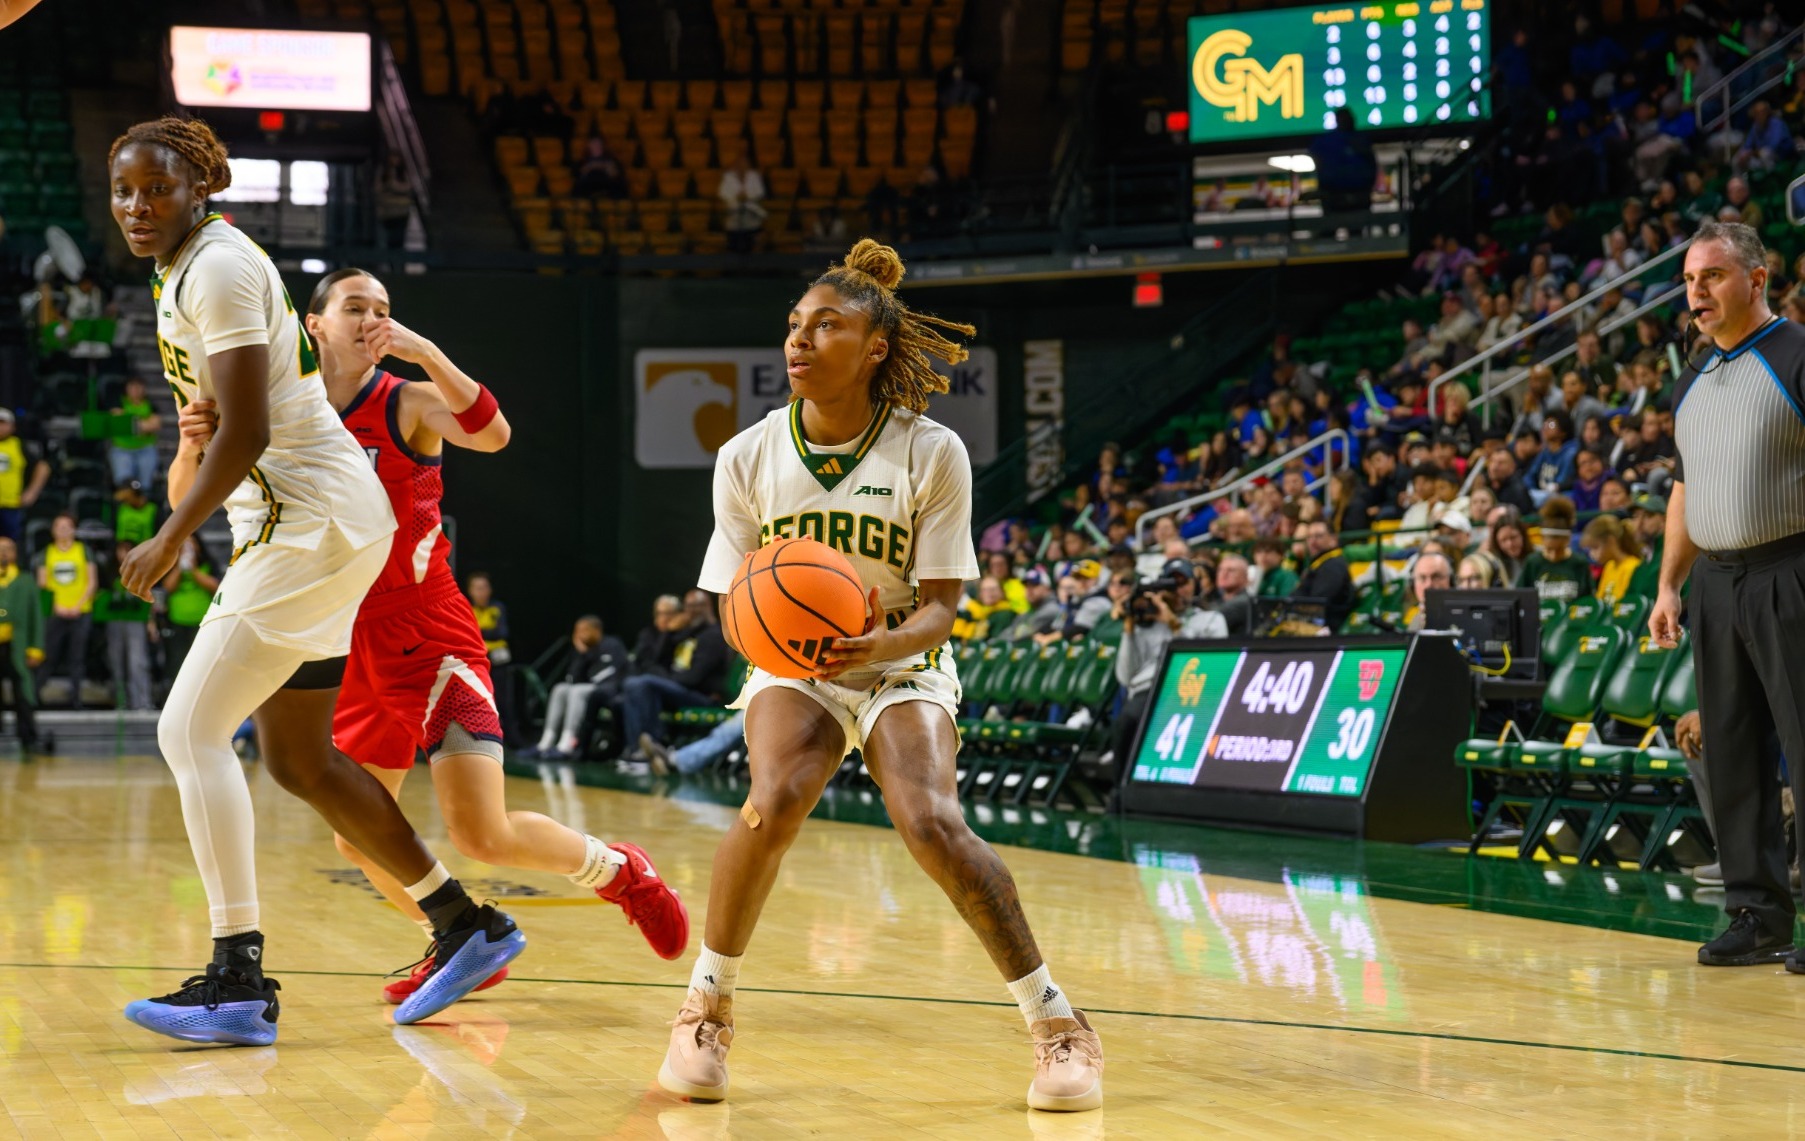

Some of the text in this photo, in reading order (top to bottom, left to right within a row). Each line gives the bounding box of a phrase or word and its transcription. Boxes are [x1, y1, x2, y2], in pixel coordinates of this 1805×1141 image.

[1241, 661, 1314, 714] 4:40
[1154, 713, 1194, 761] 41
[1327, 707, 1375, 760] 30
